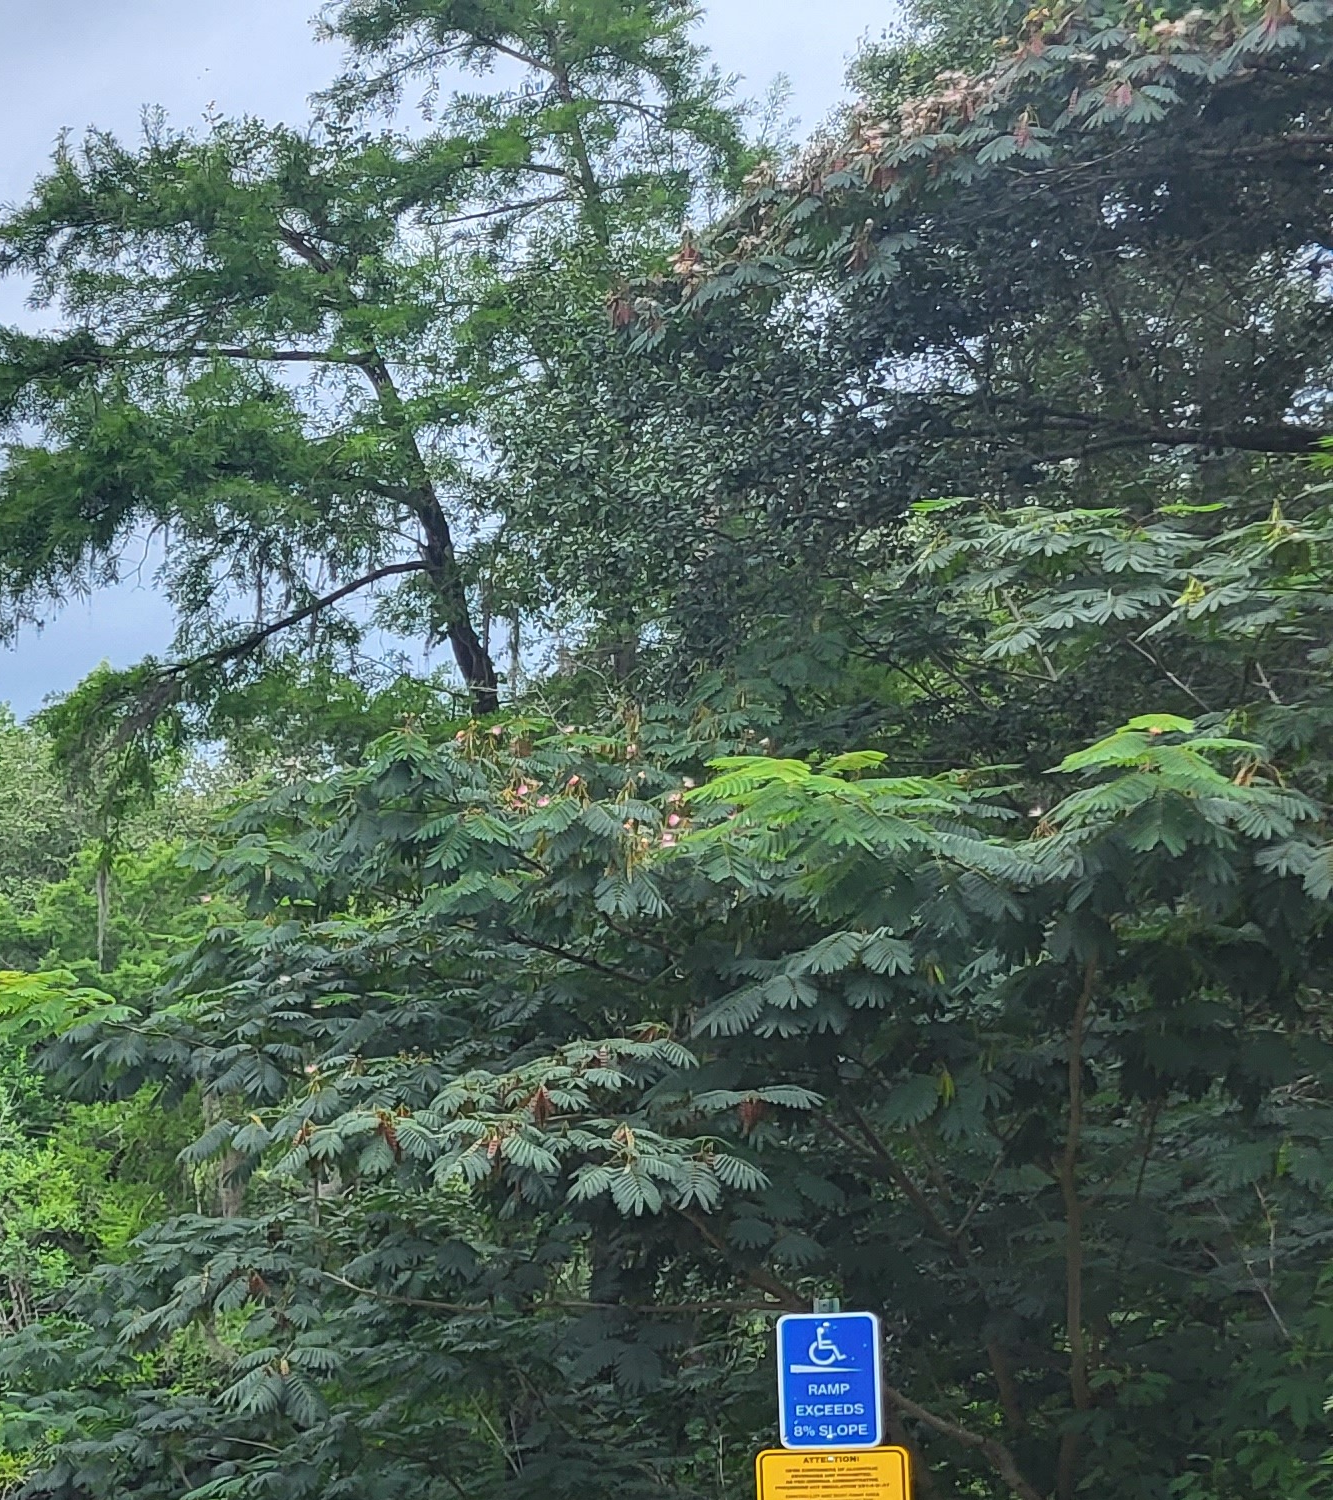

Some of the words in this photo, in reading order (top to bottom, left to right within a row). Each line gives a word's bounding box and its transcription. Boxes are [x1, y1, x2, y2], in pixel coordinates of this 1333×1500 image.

[808, 1383, 850, 1396] RAMP
[795, 1403, 865, 1417] EXCEEDS
[793, 1425, 816, 1437] 8%
[818, 1424, 869, 1437] SLOPE
